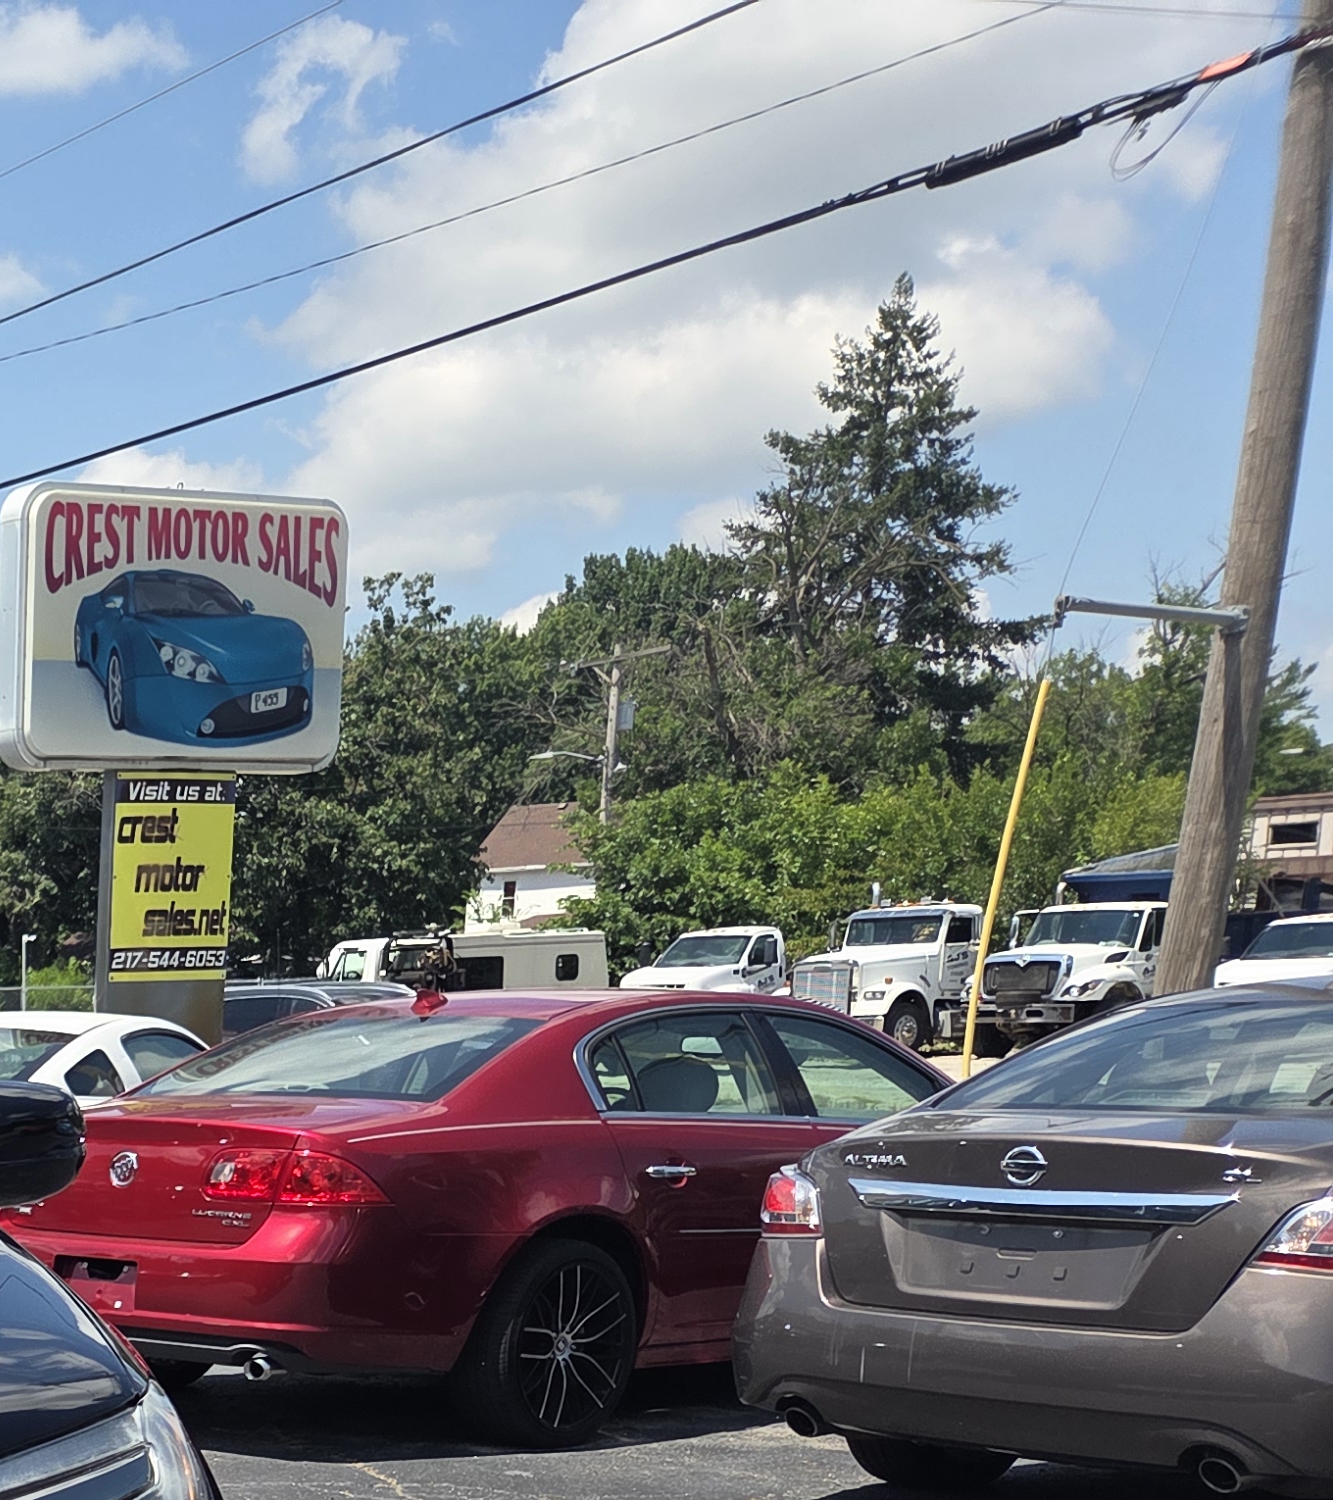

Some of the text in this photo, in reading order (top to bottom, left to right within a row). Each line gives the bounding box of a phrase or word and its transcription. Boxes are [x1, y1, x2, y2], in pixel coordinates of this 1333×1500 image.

[44, 501, 339, 607] CREST MOTOR SALES
[129, 781, 171, 801] Visit
[175, 785, 200, 801] us
[116, 807, 179, 844] crest
[134, 856, 205, 893] motor
[142, 900, 227, 937] sales.net
[111, 950, 225, 969] 217-544-6053
